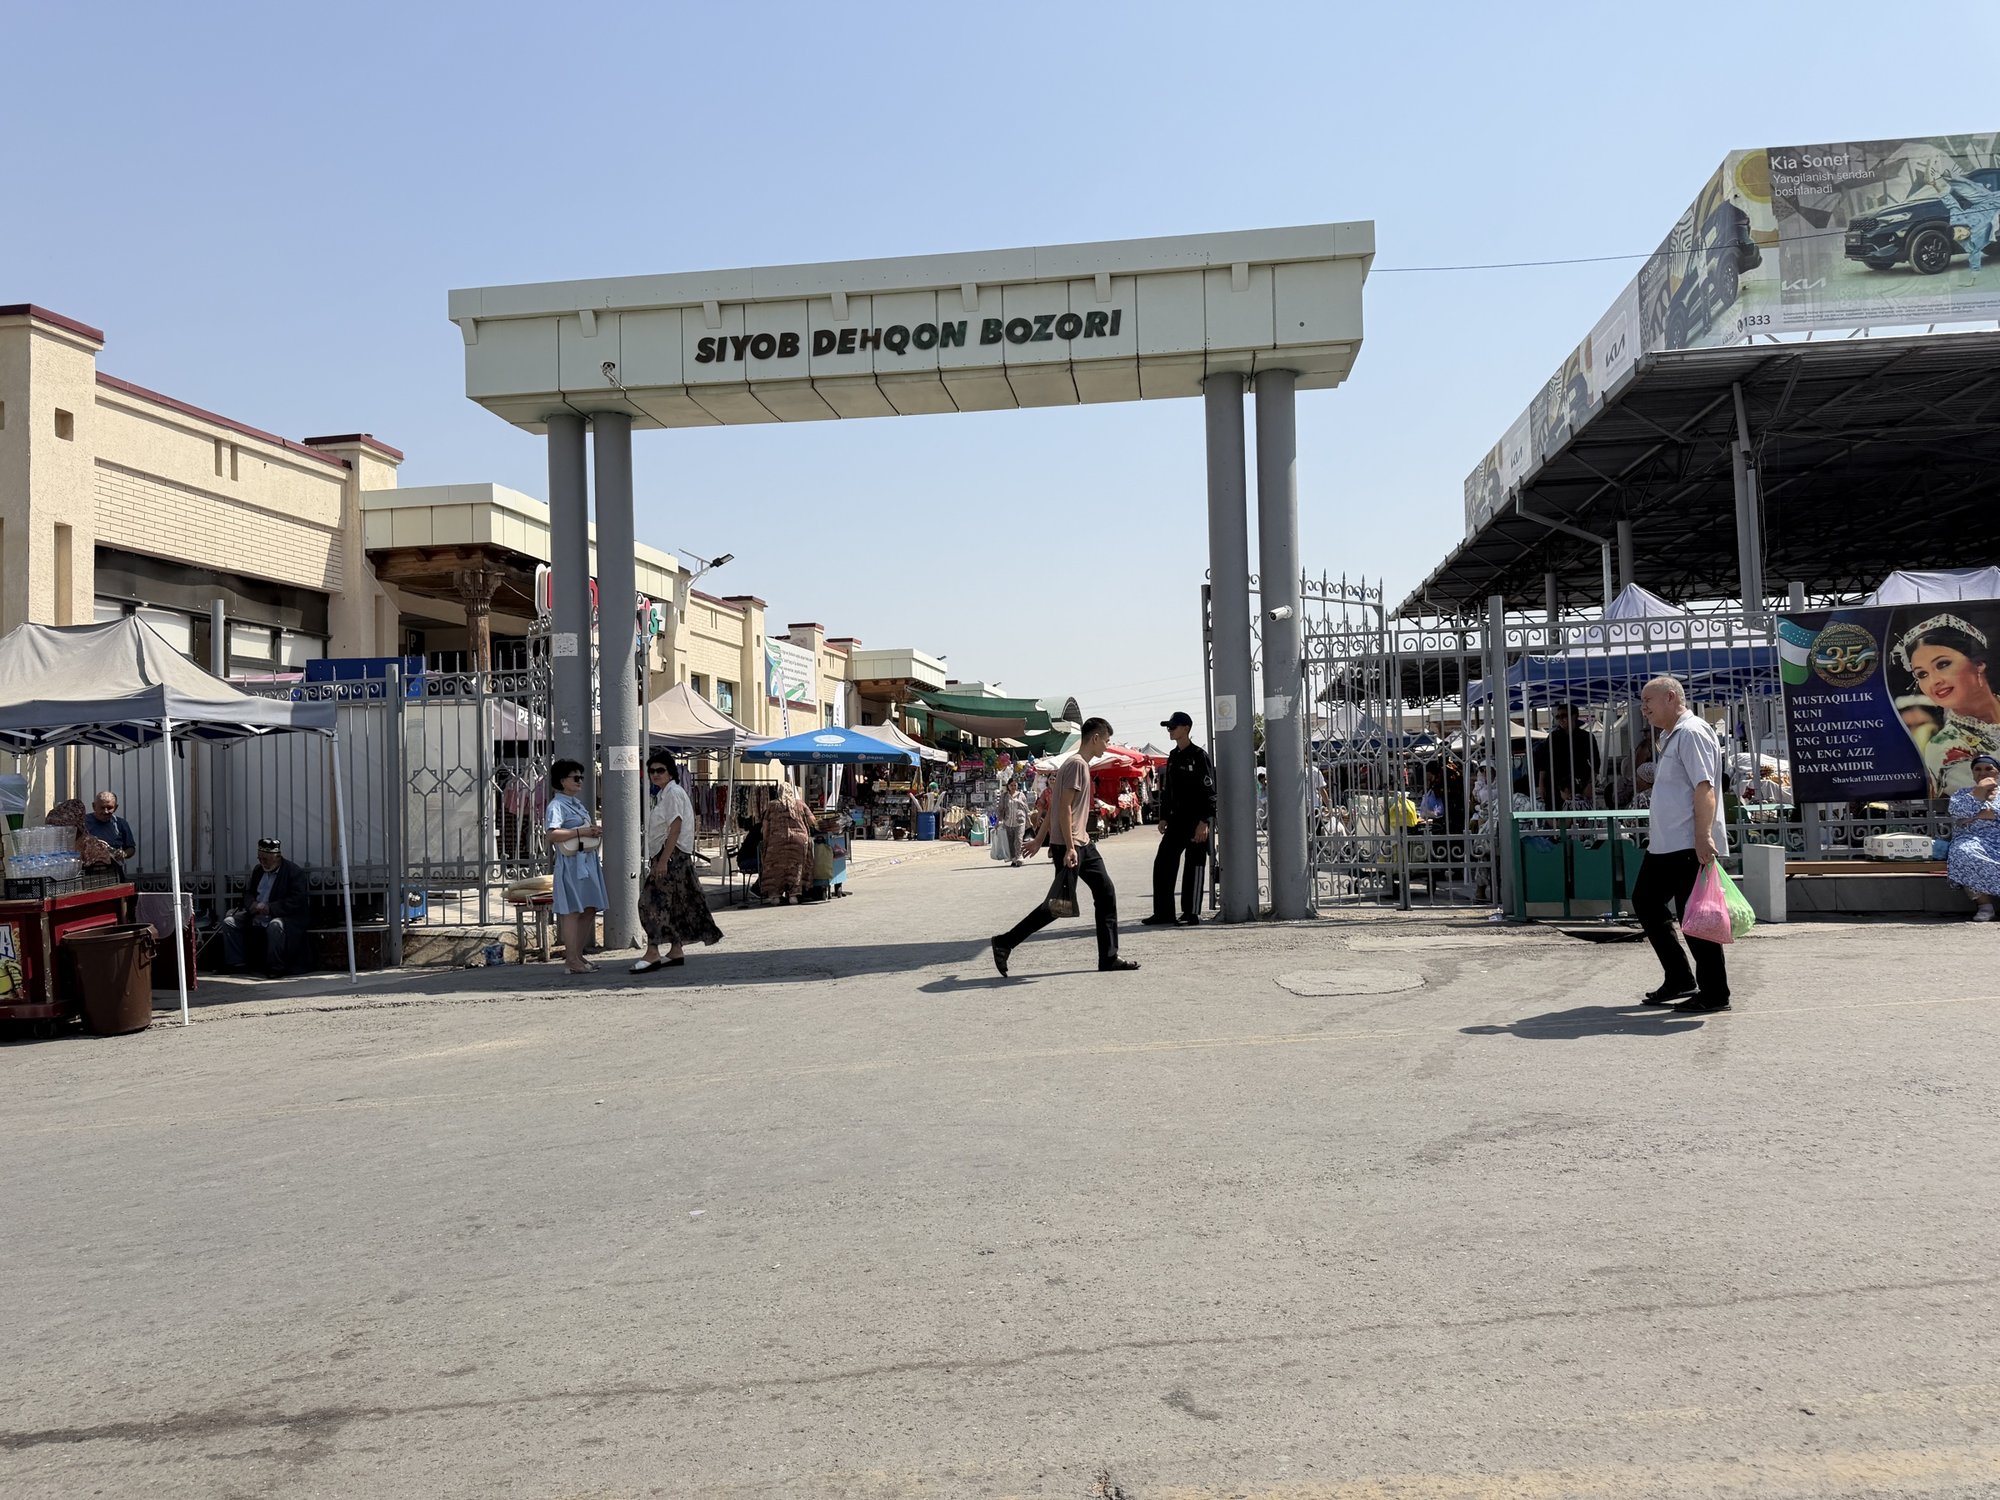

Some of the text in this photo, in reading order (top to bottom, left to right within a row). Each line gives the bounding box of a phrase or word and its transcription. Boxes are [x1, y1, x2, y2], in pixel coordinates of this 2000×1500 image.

[1770, 152, 1850, 171] Kia Sonet
[1773, 169, 1876, 186] Yangilanish sendan
[1774, 184, 1833, 198] boshlanadi
[1743, 314, 1771, 328] 1333
[695, 309, 1122, 364] SIYOB DEHQON BOZORI
[1826, 644, 1866, 674] 35
[1792, 692, 1874, 706] MUSTAQILLIK
[1793, 709, 1823, 719] KUNI
[1794, 719, 1884, 733] XALQIMIZNING
[1796, 736, 1820, 747] ENG
[1796, 750, 1812, 760] VA
[1816, 749, 1841, 759] ENG
[1846, 747, 1875, 758] AZIZ
[1798, 761, 1875, 774] BAYRAMIDIR
[1832, 772, 1921, 785] Shavkat MIRZIYOYEV.
